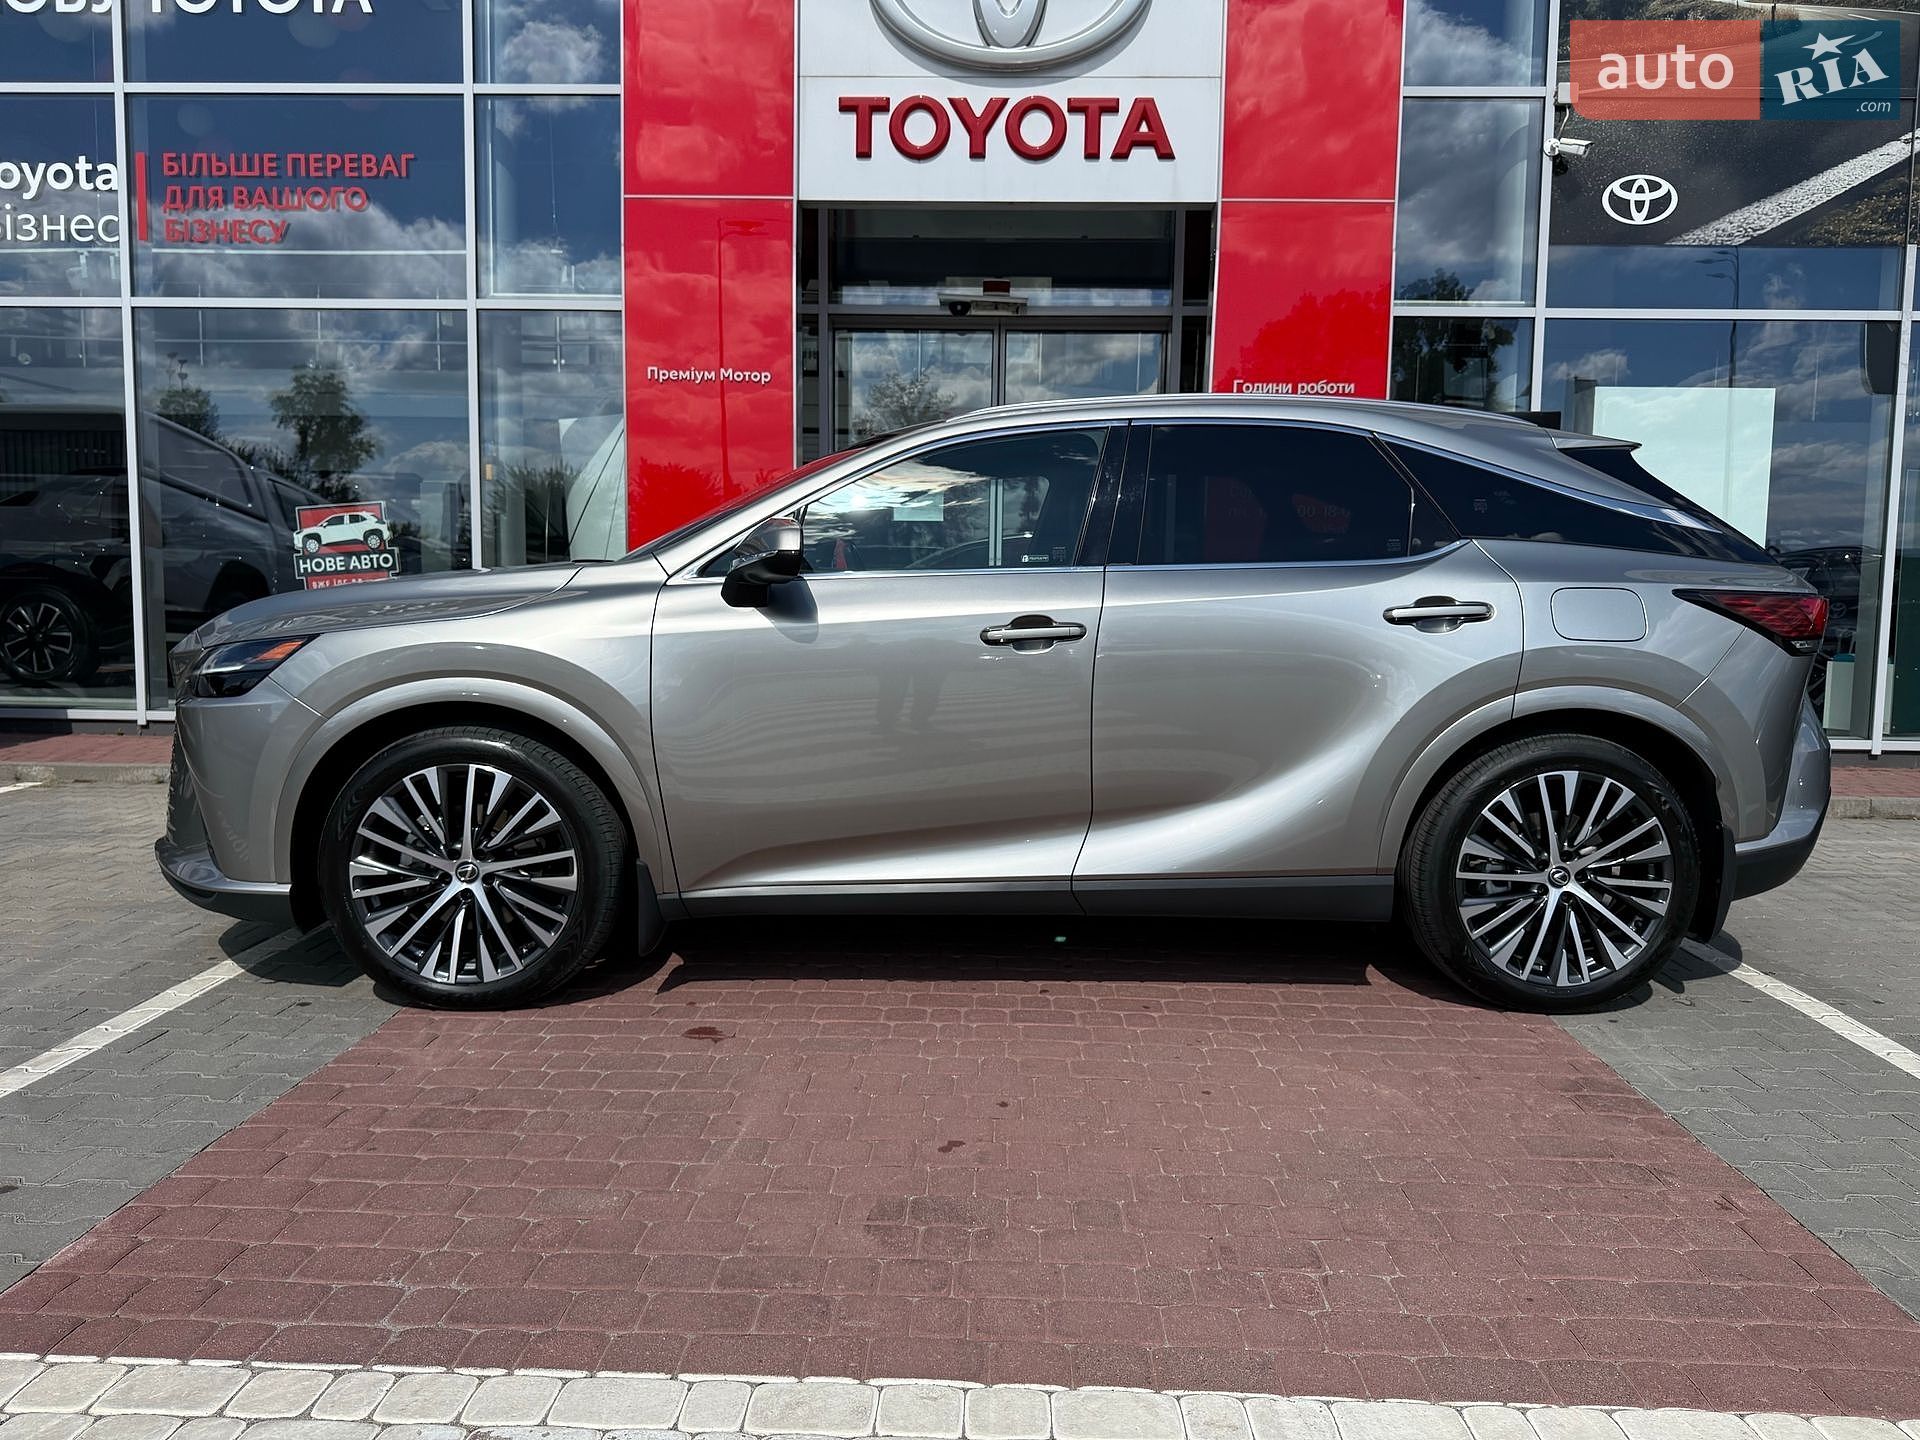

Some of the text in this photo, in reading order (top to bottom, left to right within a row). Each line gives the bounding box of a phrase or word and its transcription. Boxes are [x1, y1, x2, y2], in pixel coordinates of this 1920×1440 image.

[839, 95, 1176, 160] TOYOTA
[163, 153, 415, 177] БІЛЬШЕ ПЕРЕВАГ
[162, 186, 368, 213] ДЛЯ ВАШОГО
[0, 203, 119, 242] ізнес
[165, 219, 287, 243] БІЗНЕСУ
[647, 366, 771, 384] Преміум Мотор
[1233, 380, 1355, 395] Години роботи
[300, 554, 393, 573] НОВЕ АВТО
